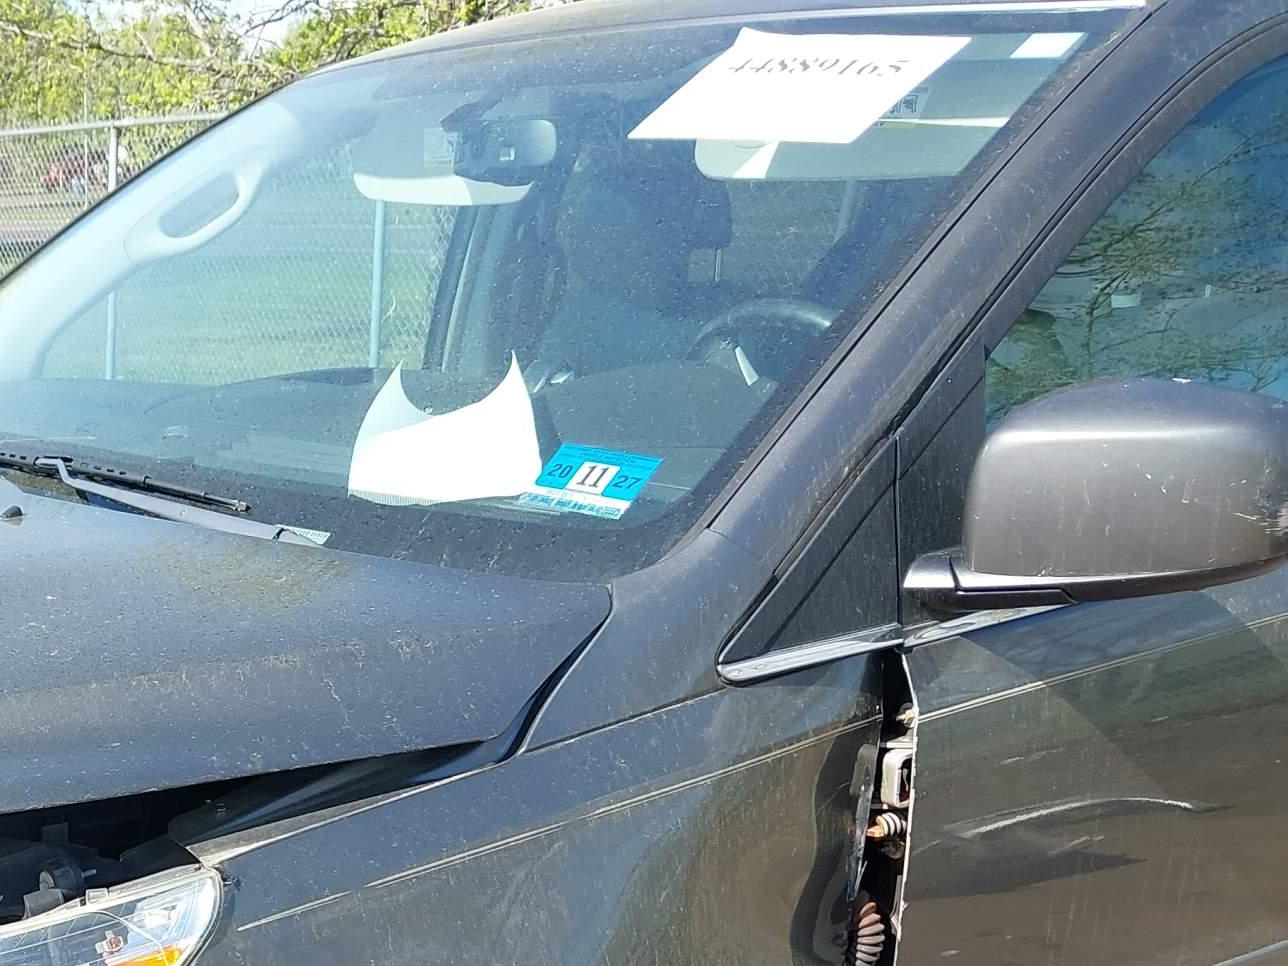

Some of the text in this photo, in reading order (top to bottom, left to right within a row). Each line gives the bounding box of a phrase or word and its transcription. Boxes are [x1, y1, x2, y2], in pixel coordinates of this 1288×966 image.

[547, 463, 643, 490] 20 11 27
